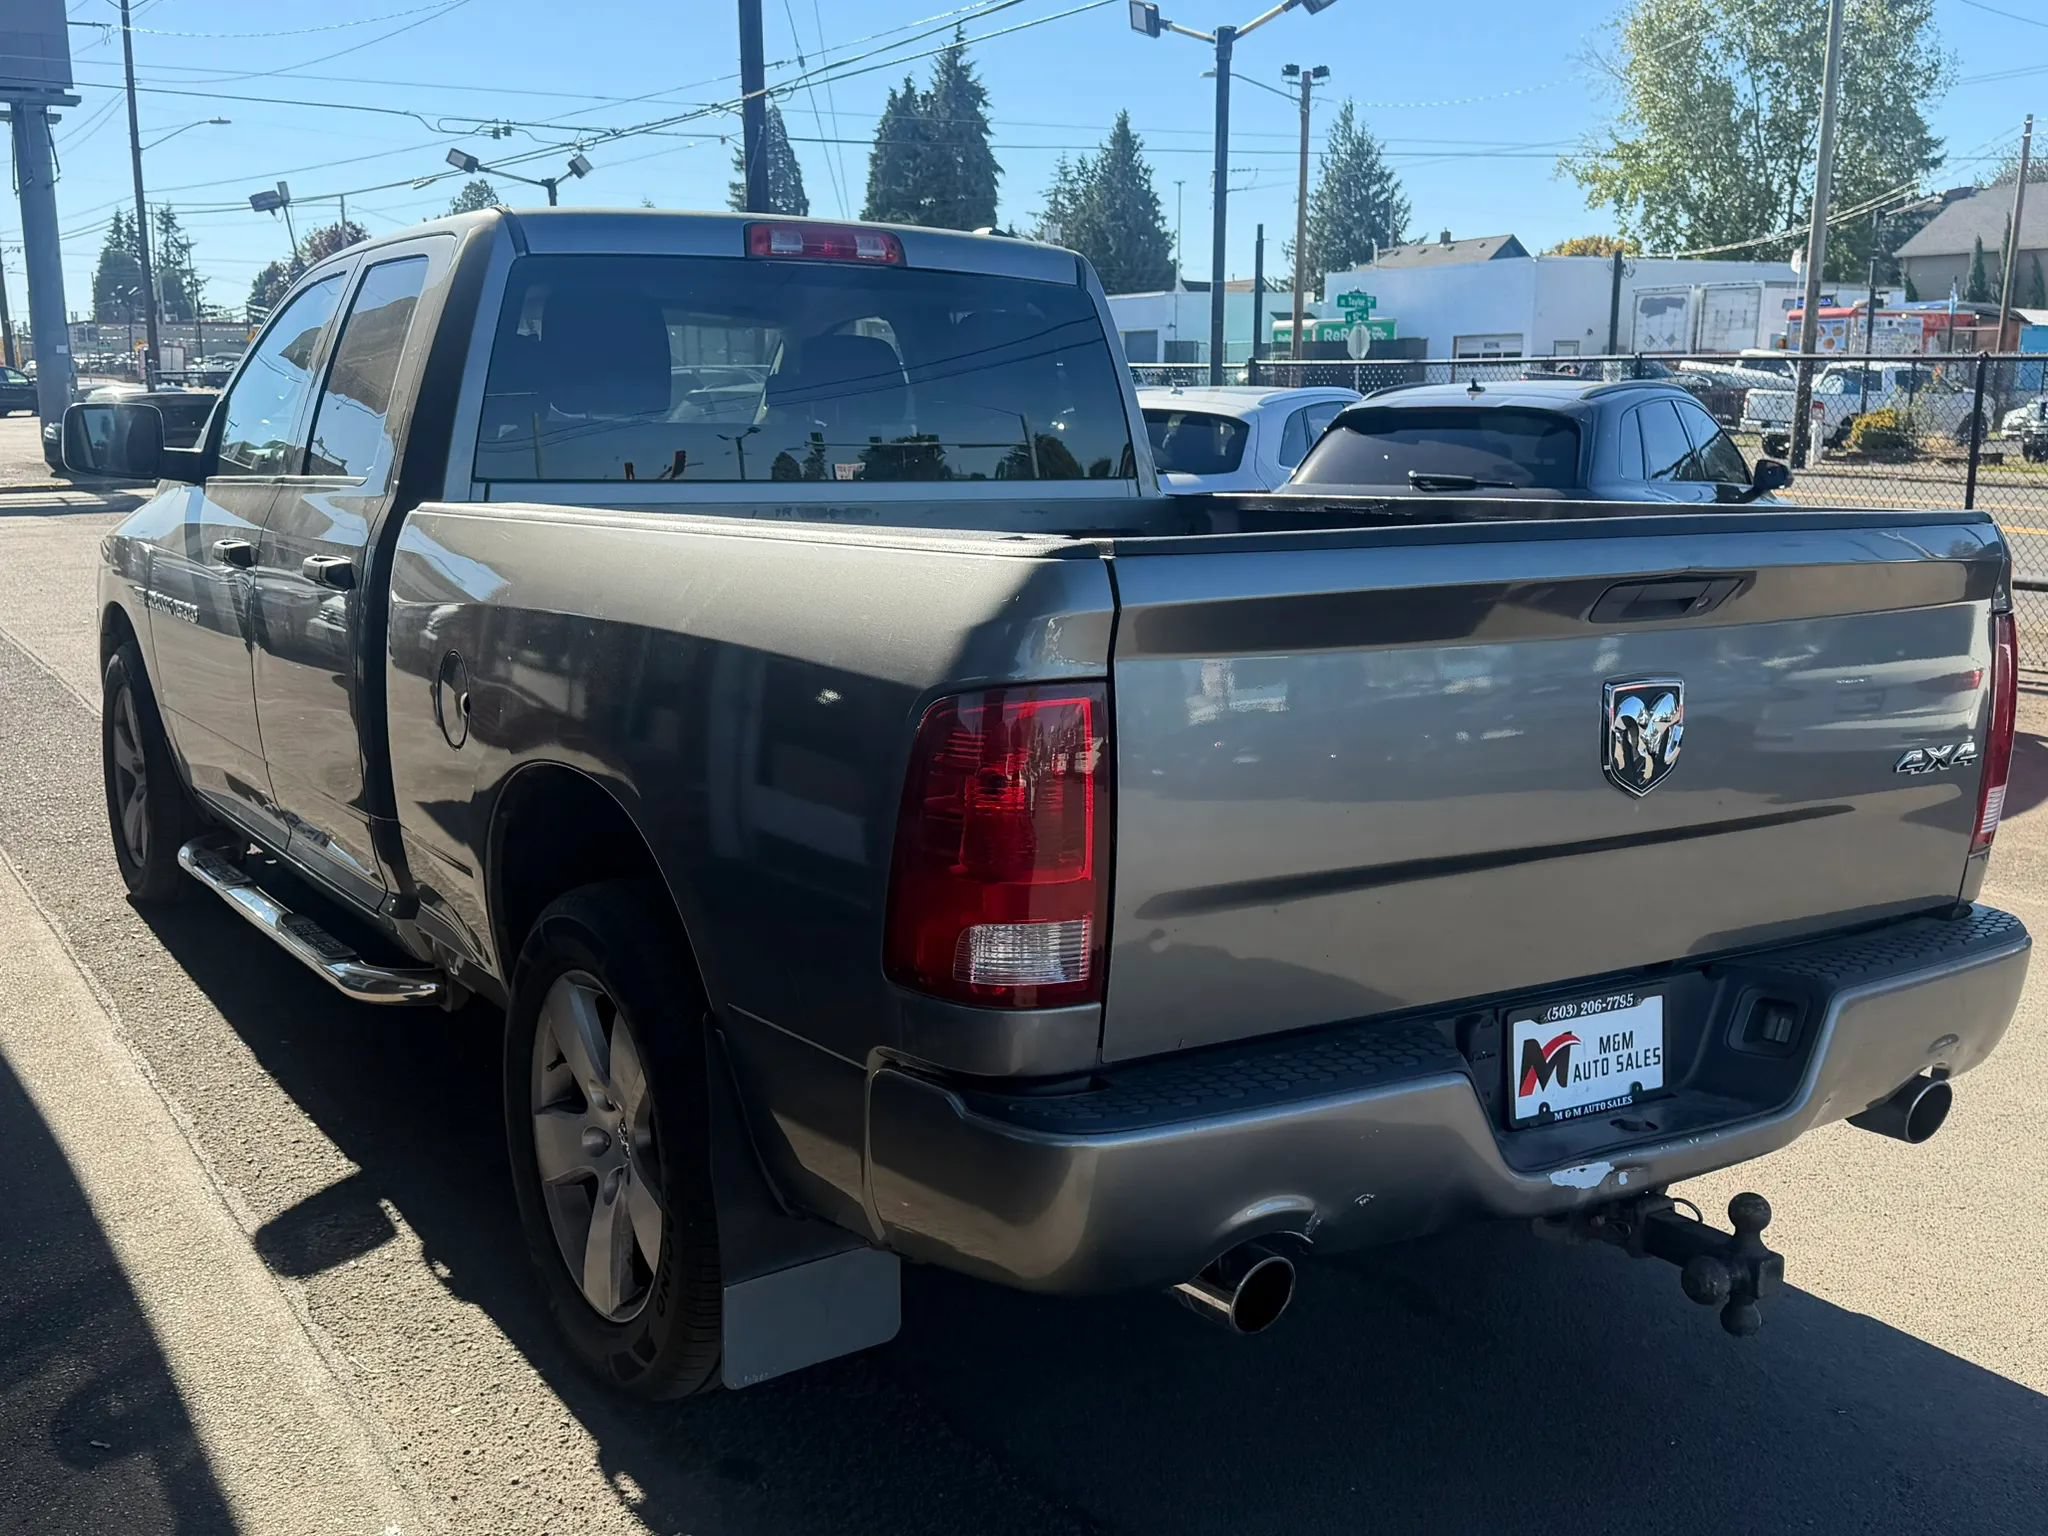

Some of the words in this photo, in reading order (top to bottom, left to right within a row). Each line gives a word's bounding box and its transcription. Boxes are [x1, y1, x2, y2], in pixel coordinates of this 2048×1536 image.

[1547, 1004, 1577, 1021] (503)
[1580, 993, 1634, 1015] 206-7795
[1599, 1030, 1634, 1055] M&M
[1573, 1057, 1609, 1083] AUTO
[1616, 1047, 1661, 1073] SALES
[1554, 1111, 1563, 1121] M
[1565, 1109, 1572, 1119] &
[1573, 1107, 1582, 1117] M
[1583, 1102, 1606, 1115] AUTO
[1607, 1096, 1633, 1109] SALES
